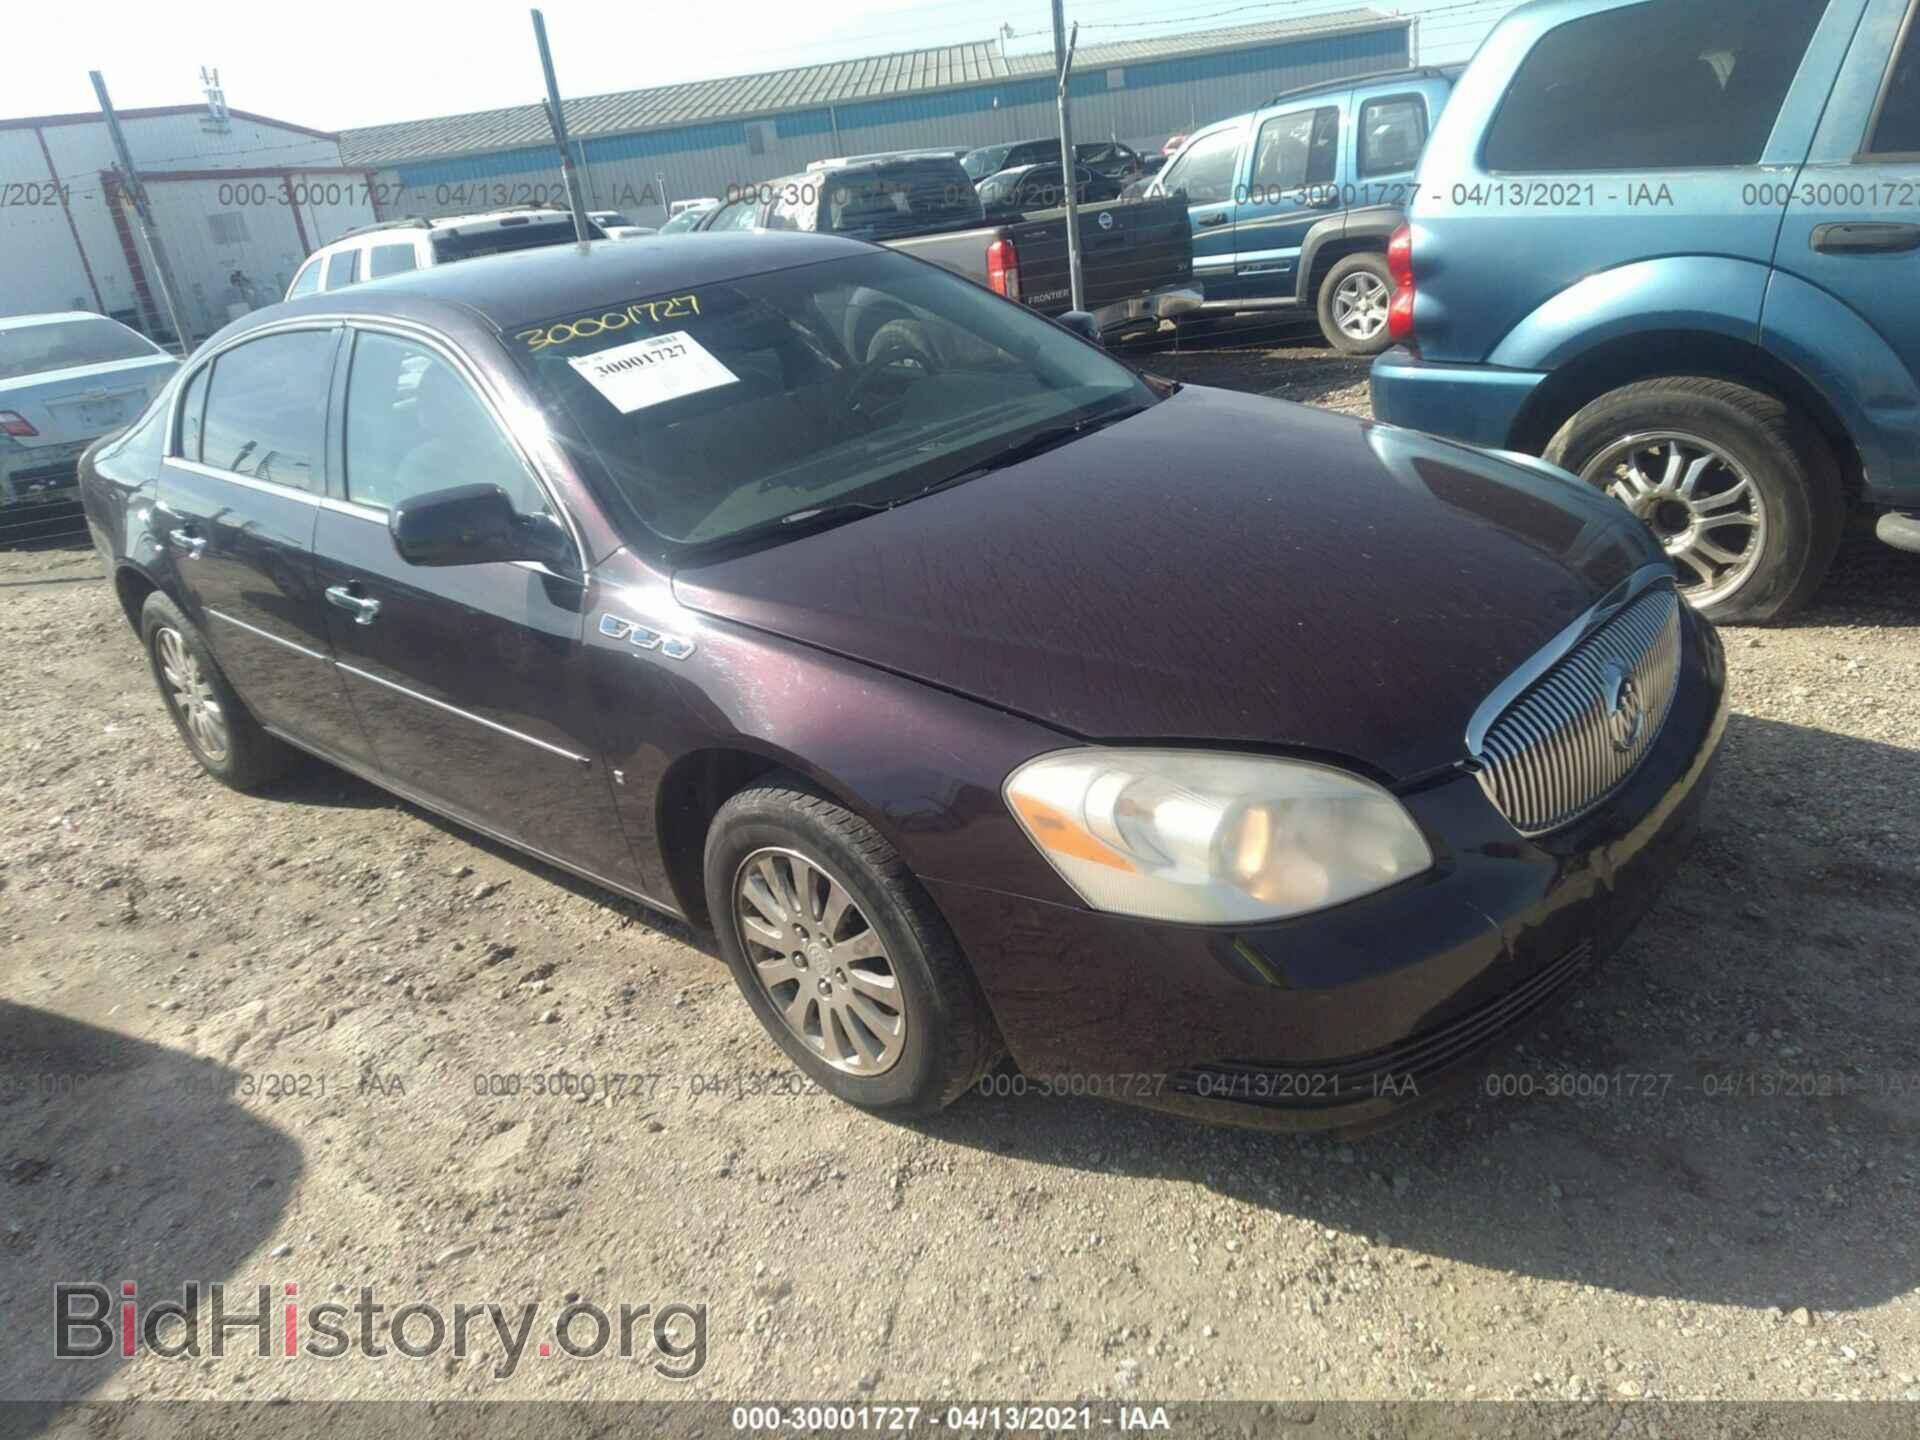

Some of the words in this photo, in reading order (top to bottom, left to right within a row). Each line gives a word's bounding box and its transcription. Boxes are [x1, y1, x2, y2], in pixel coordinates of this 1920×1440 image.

[1028, 288, 1070, 305] FRONTIER
[515, 295, 700, 352] 30001727
[594, 344, 687, 377] 30001727
